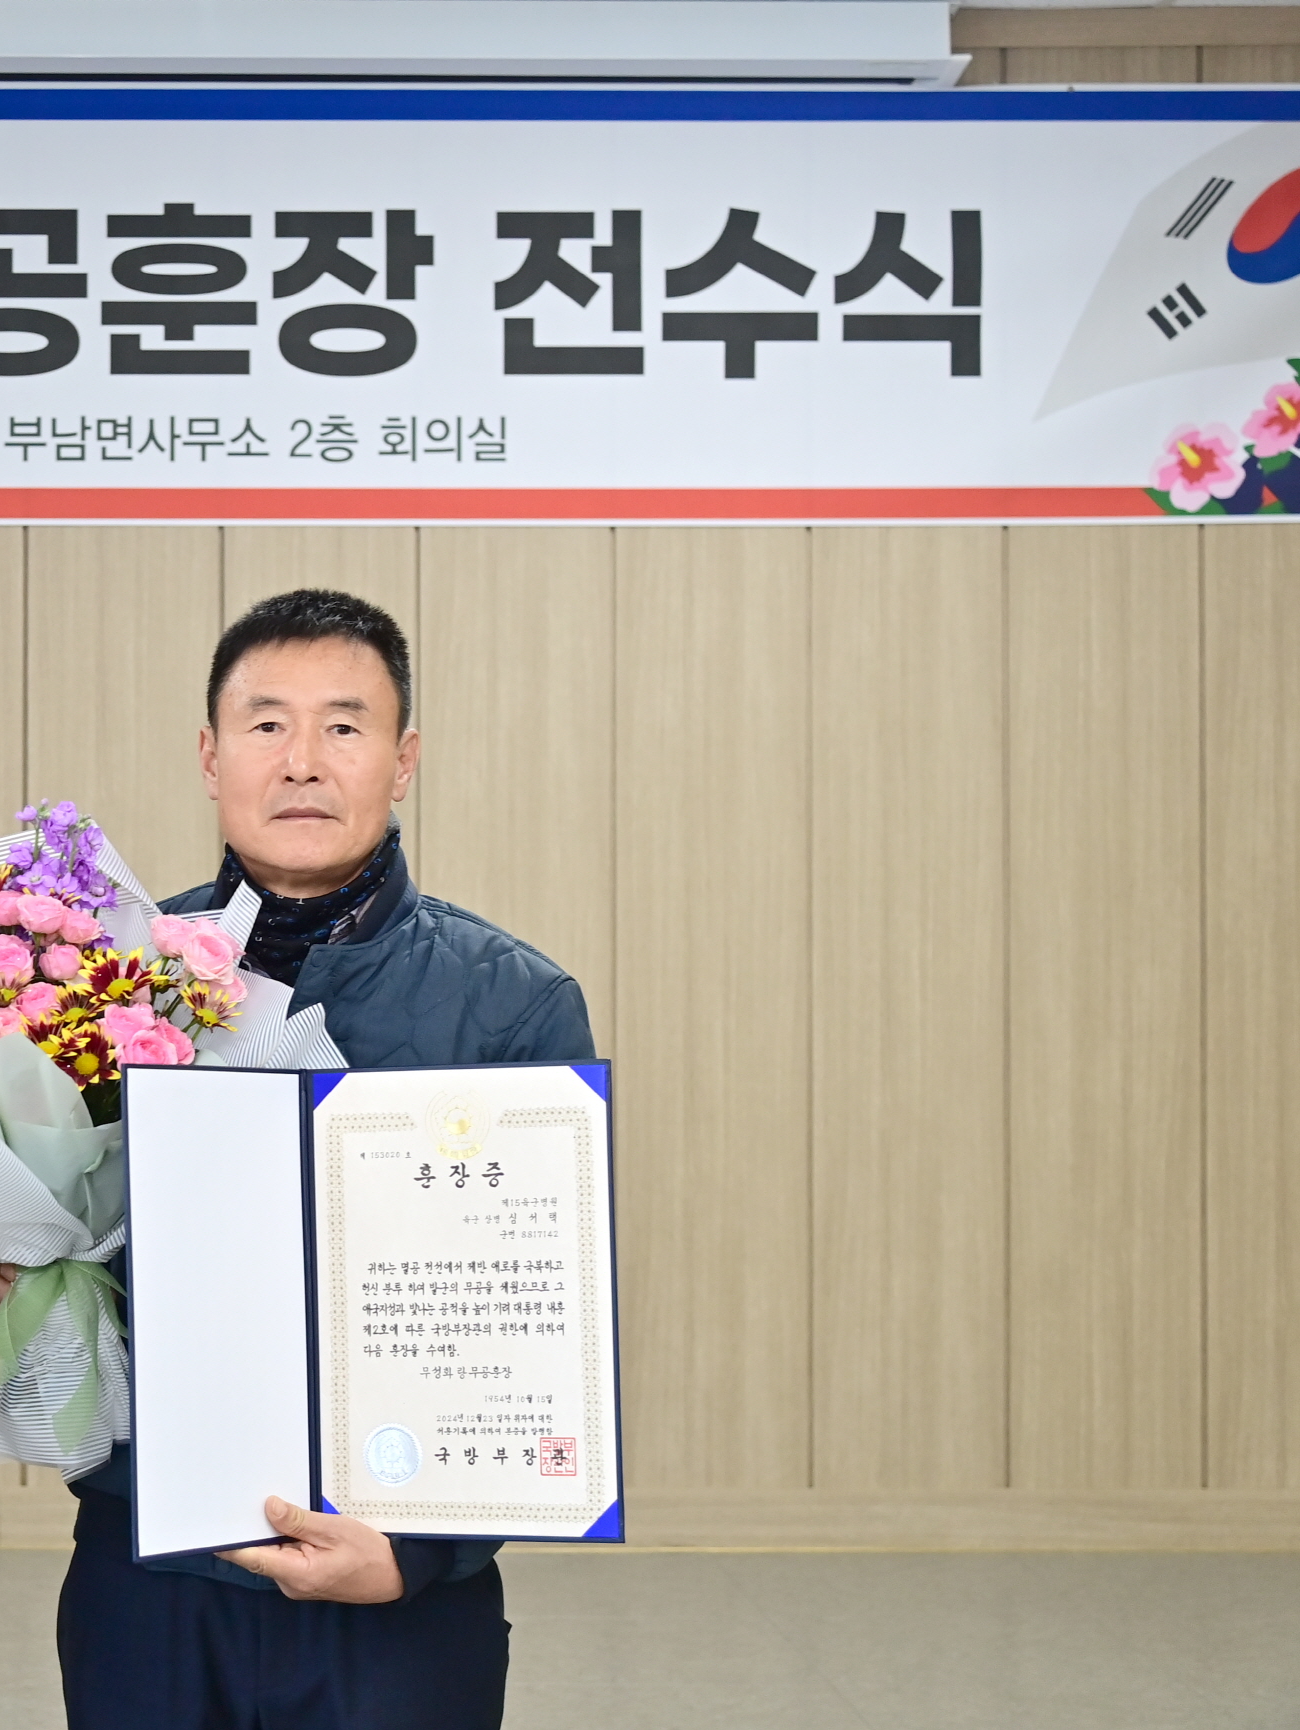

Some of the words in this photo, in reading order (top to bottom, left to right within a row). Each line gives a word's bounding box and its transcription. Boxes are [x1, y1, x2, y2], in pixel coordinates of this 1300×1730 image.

[493, 206, 984, 380] 전수식
[3, 415, 270, 462] 부남면사무소
[289, 415, 359, 463] 2층
[378, 415, 507, 463] 회의실
[366, 1261, 398, 1276] 귀하는
[400, 1260, 421, 1276] 멸공
[423, 1260, 463, 1275] 전선에서
[466, 1259, 488, 1275] 제반
[490, 1259, 521, 1275] 애로를
[522, 1259, 565, 1274] 극복하고
[361, 1281, 379, 1297] 헌신
[428, 1281, 459, 1296] 발군의
[462, 1280, 495, 1296] 무공을
[553, 1281, 565, 1291] 그
[408, 1301, 437, 1317] 빛나는
[437, 1301, 470, 1317] 공적을
[471, 1301, 491, 1316] 높이
[492, 1301, 511, 1316] 기려
[512, 1300, 543, 1316] 대통령
[362, 1322, 399, 1338] 제2호에
[404, 1322, 426, 1337] 따른
[430, 1322, 492, 1338] 국방부장관의
[497, 1321, 529, 1337] 권한에
[534, 1321, 565, 1337] 의하여
[362, 1343, 384, 1358] 다음
[388, 1343, 420, 1358] 훈장을
[425, 1343, 460, 1358] 수여함.
